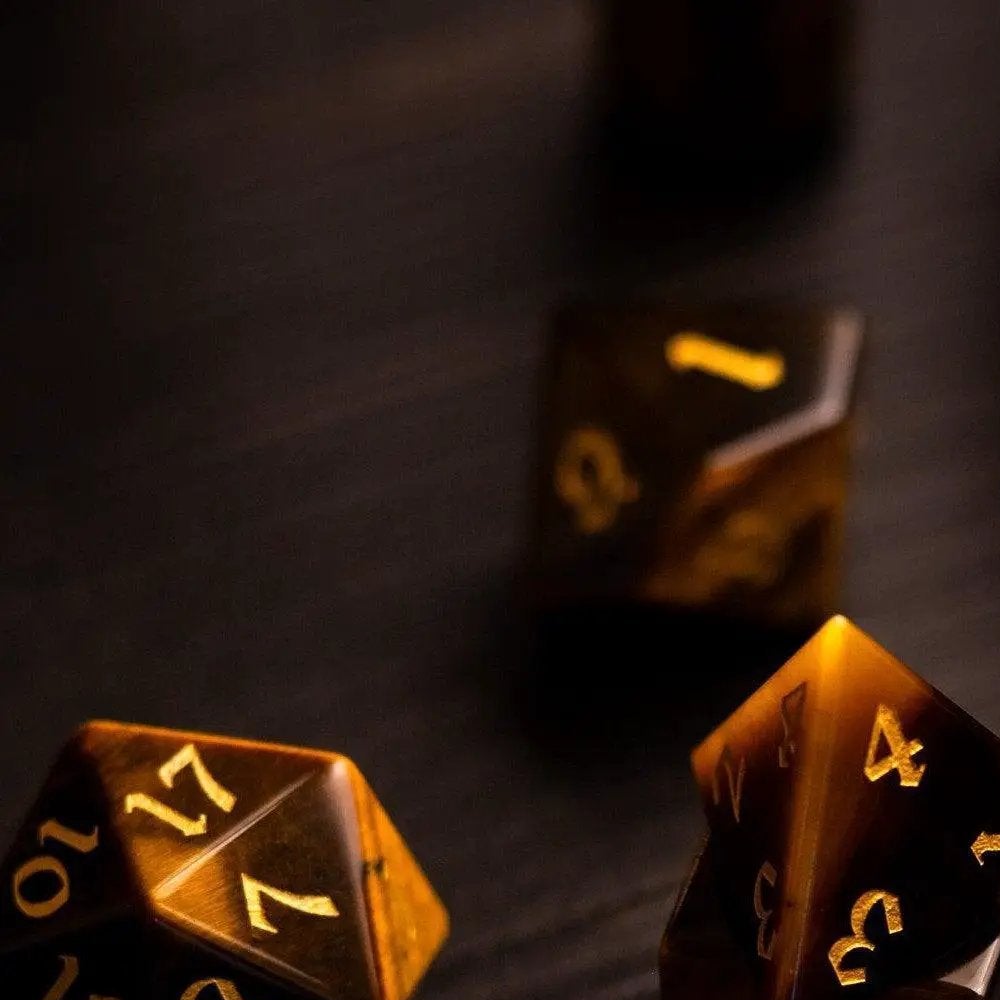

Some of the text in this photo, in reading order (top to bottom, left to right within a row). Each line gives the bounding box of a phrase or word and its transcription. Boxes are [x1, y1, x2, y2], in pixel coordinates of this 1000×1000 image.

[123, 743, 237, 837] 17
[863, 703, 928, 788] 4
[10, 816, 100, 920] 10
[240, 872, 341, 935] 7
[826, 888, 905, 988] 3
